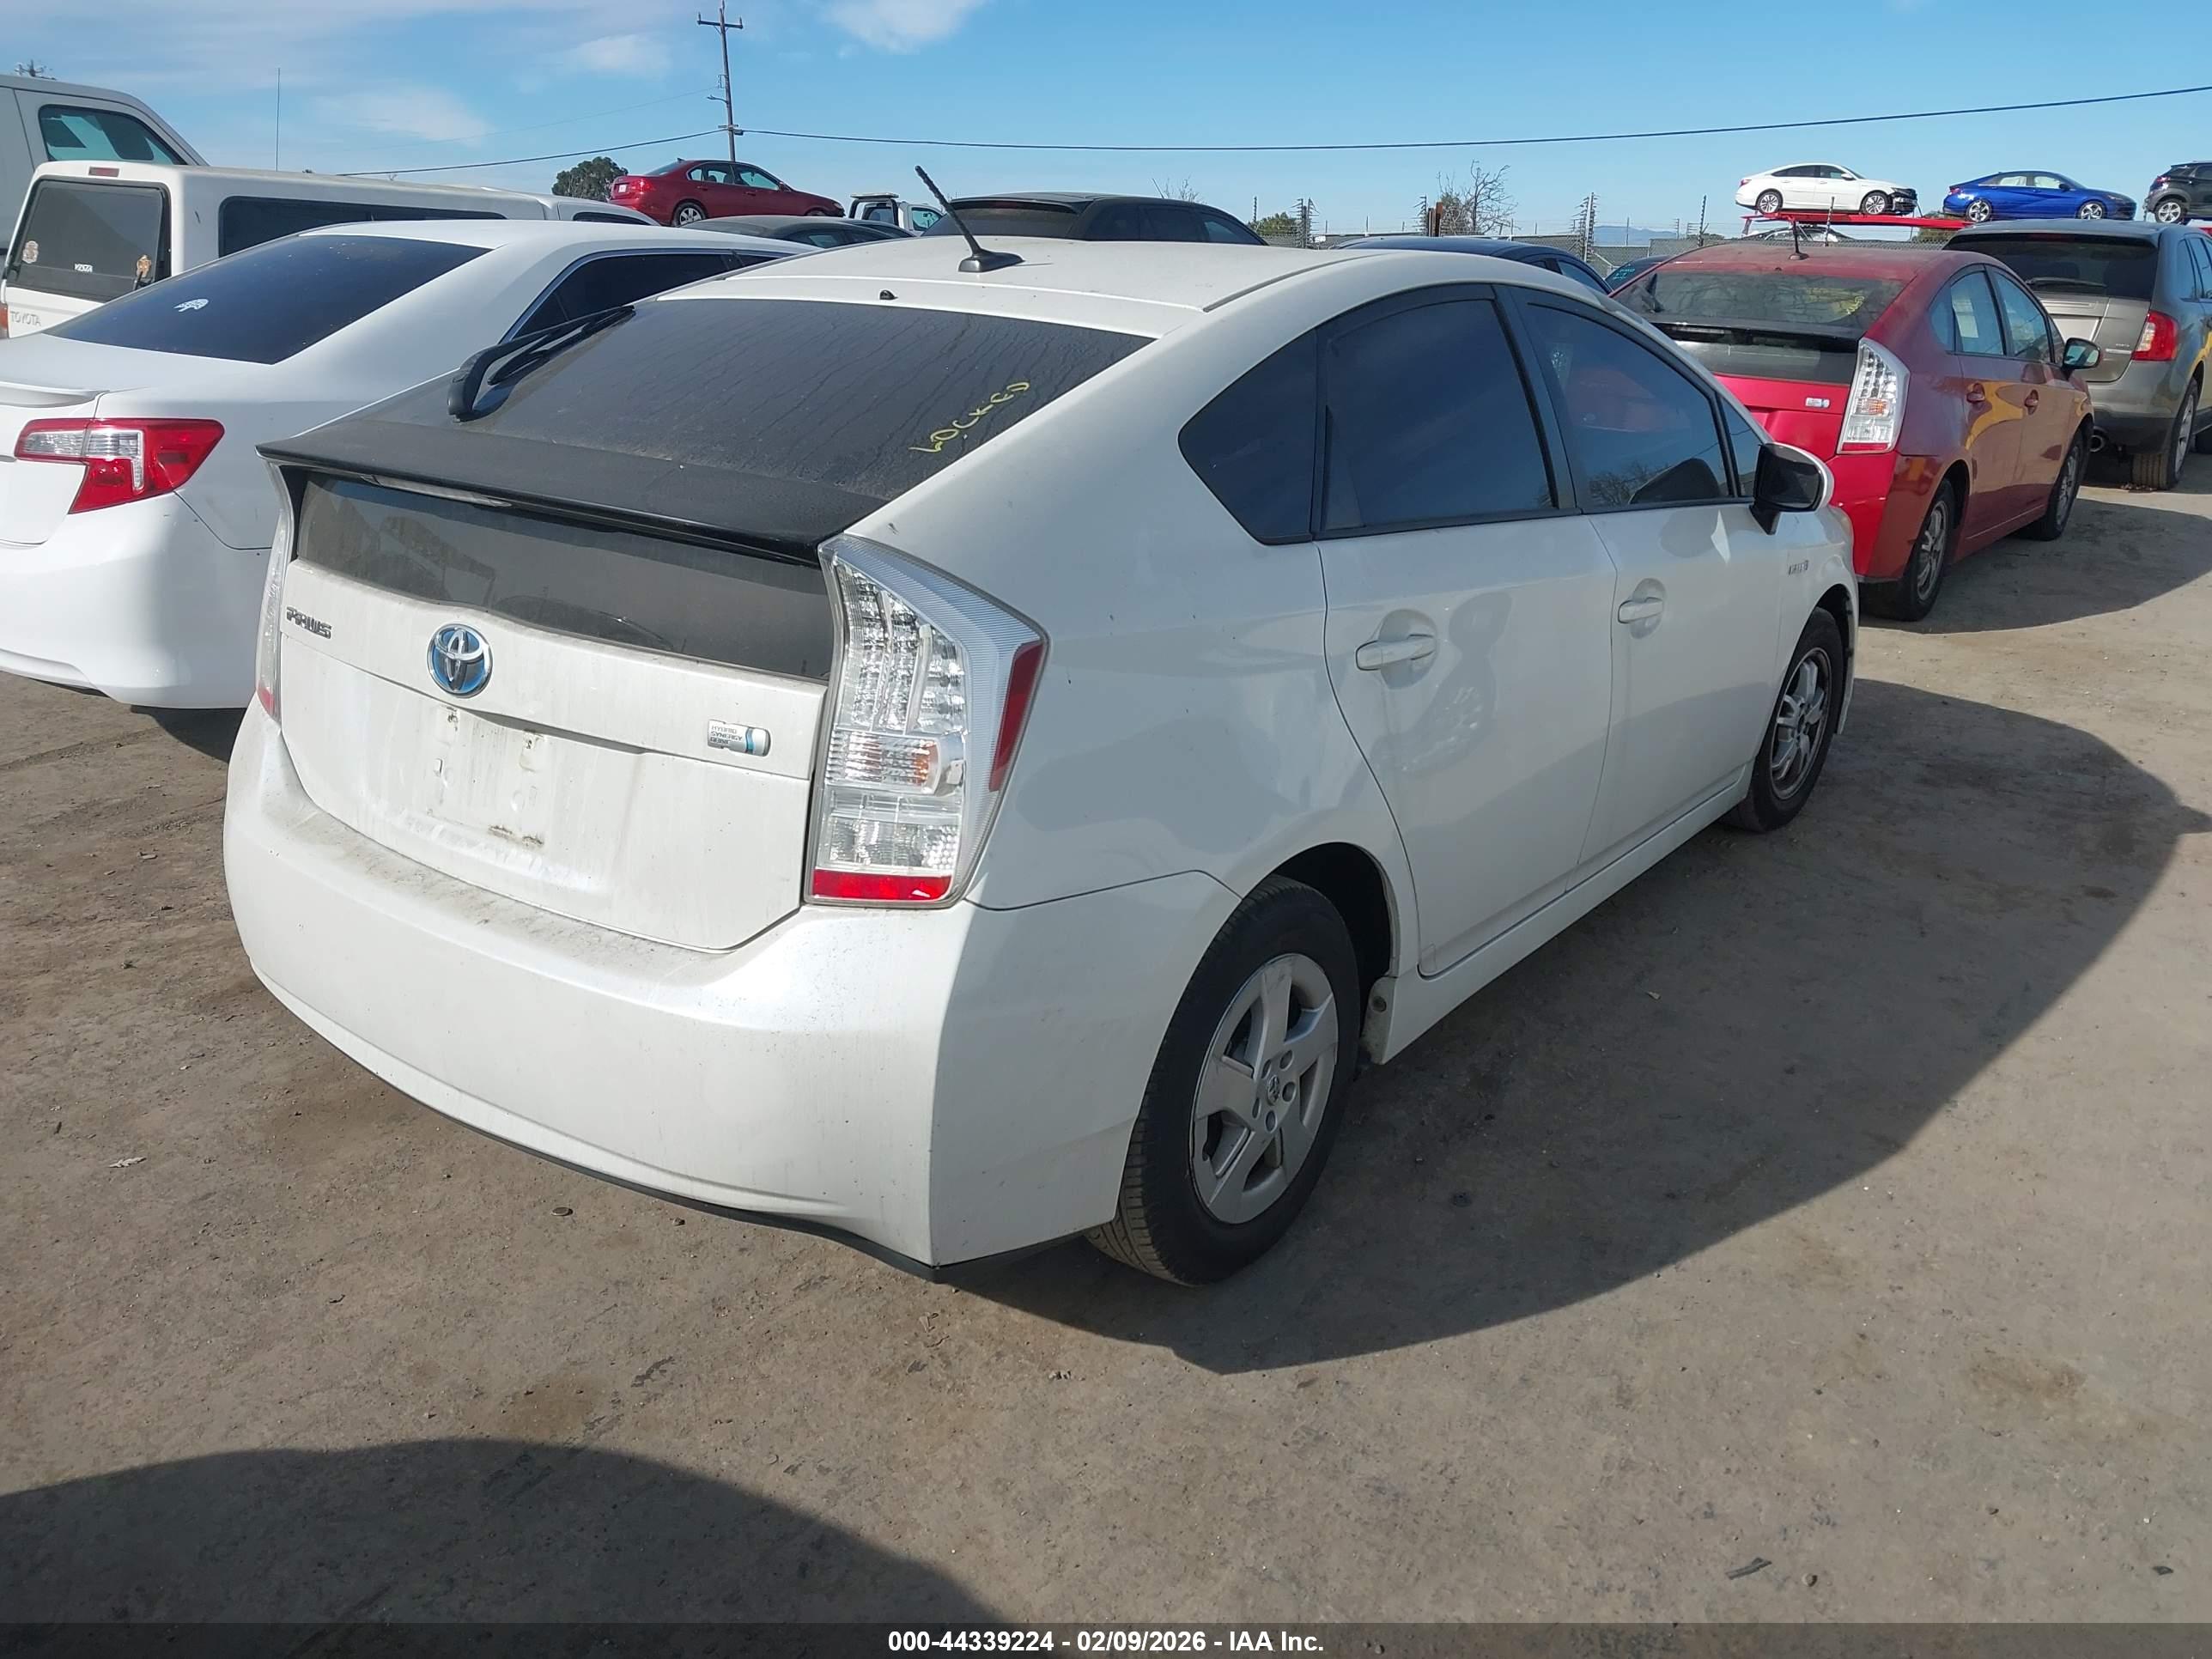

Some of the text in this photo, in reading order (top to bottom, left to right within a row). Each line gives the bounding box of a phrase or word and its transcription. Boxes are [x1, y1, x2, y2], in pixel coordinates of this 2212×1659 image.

[9, 310, 42, 326] TOYOTA
[286, 606, 332, 639] PRIUS
[711, 726, 738, 734] HYBRID
[710, 736, 731, 744] DRIVE
[711, 731, 743, 741] SYNERGY
